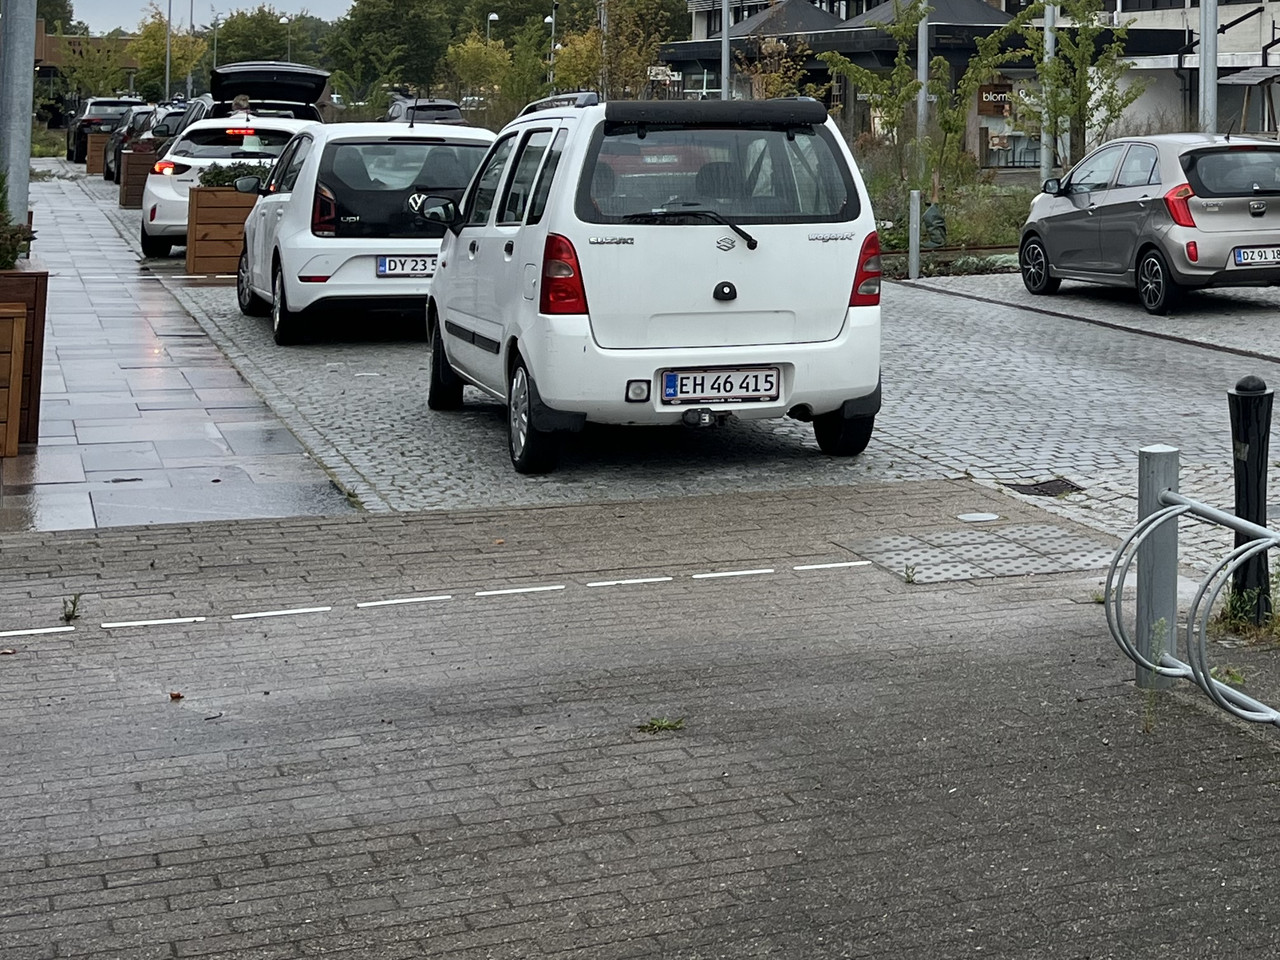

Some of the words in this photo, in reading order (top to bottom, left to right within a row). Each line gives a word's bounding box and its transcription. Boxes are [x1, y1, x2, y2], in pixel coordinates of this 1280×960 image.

[589, 236, 634, 245] SUZUKI
[1243, 250, 1255, 261] DZ
[1257, 250, 1268, 261] 91
[388, 259, 407, 271] DY
[410, 259, 427, 271] 23
[679, 375, 705, 394] EH
[710, 375, 734, 393] 46
[739, 374, 774, 392] 415
